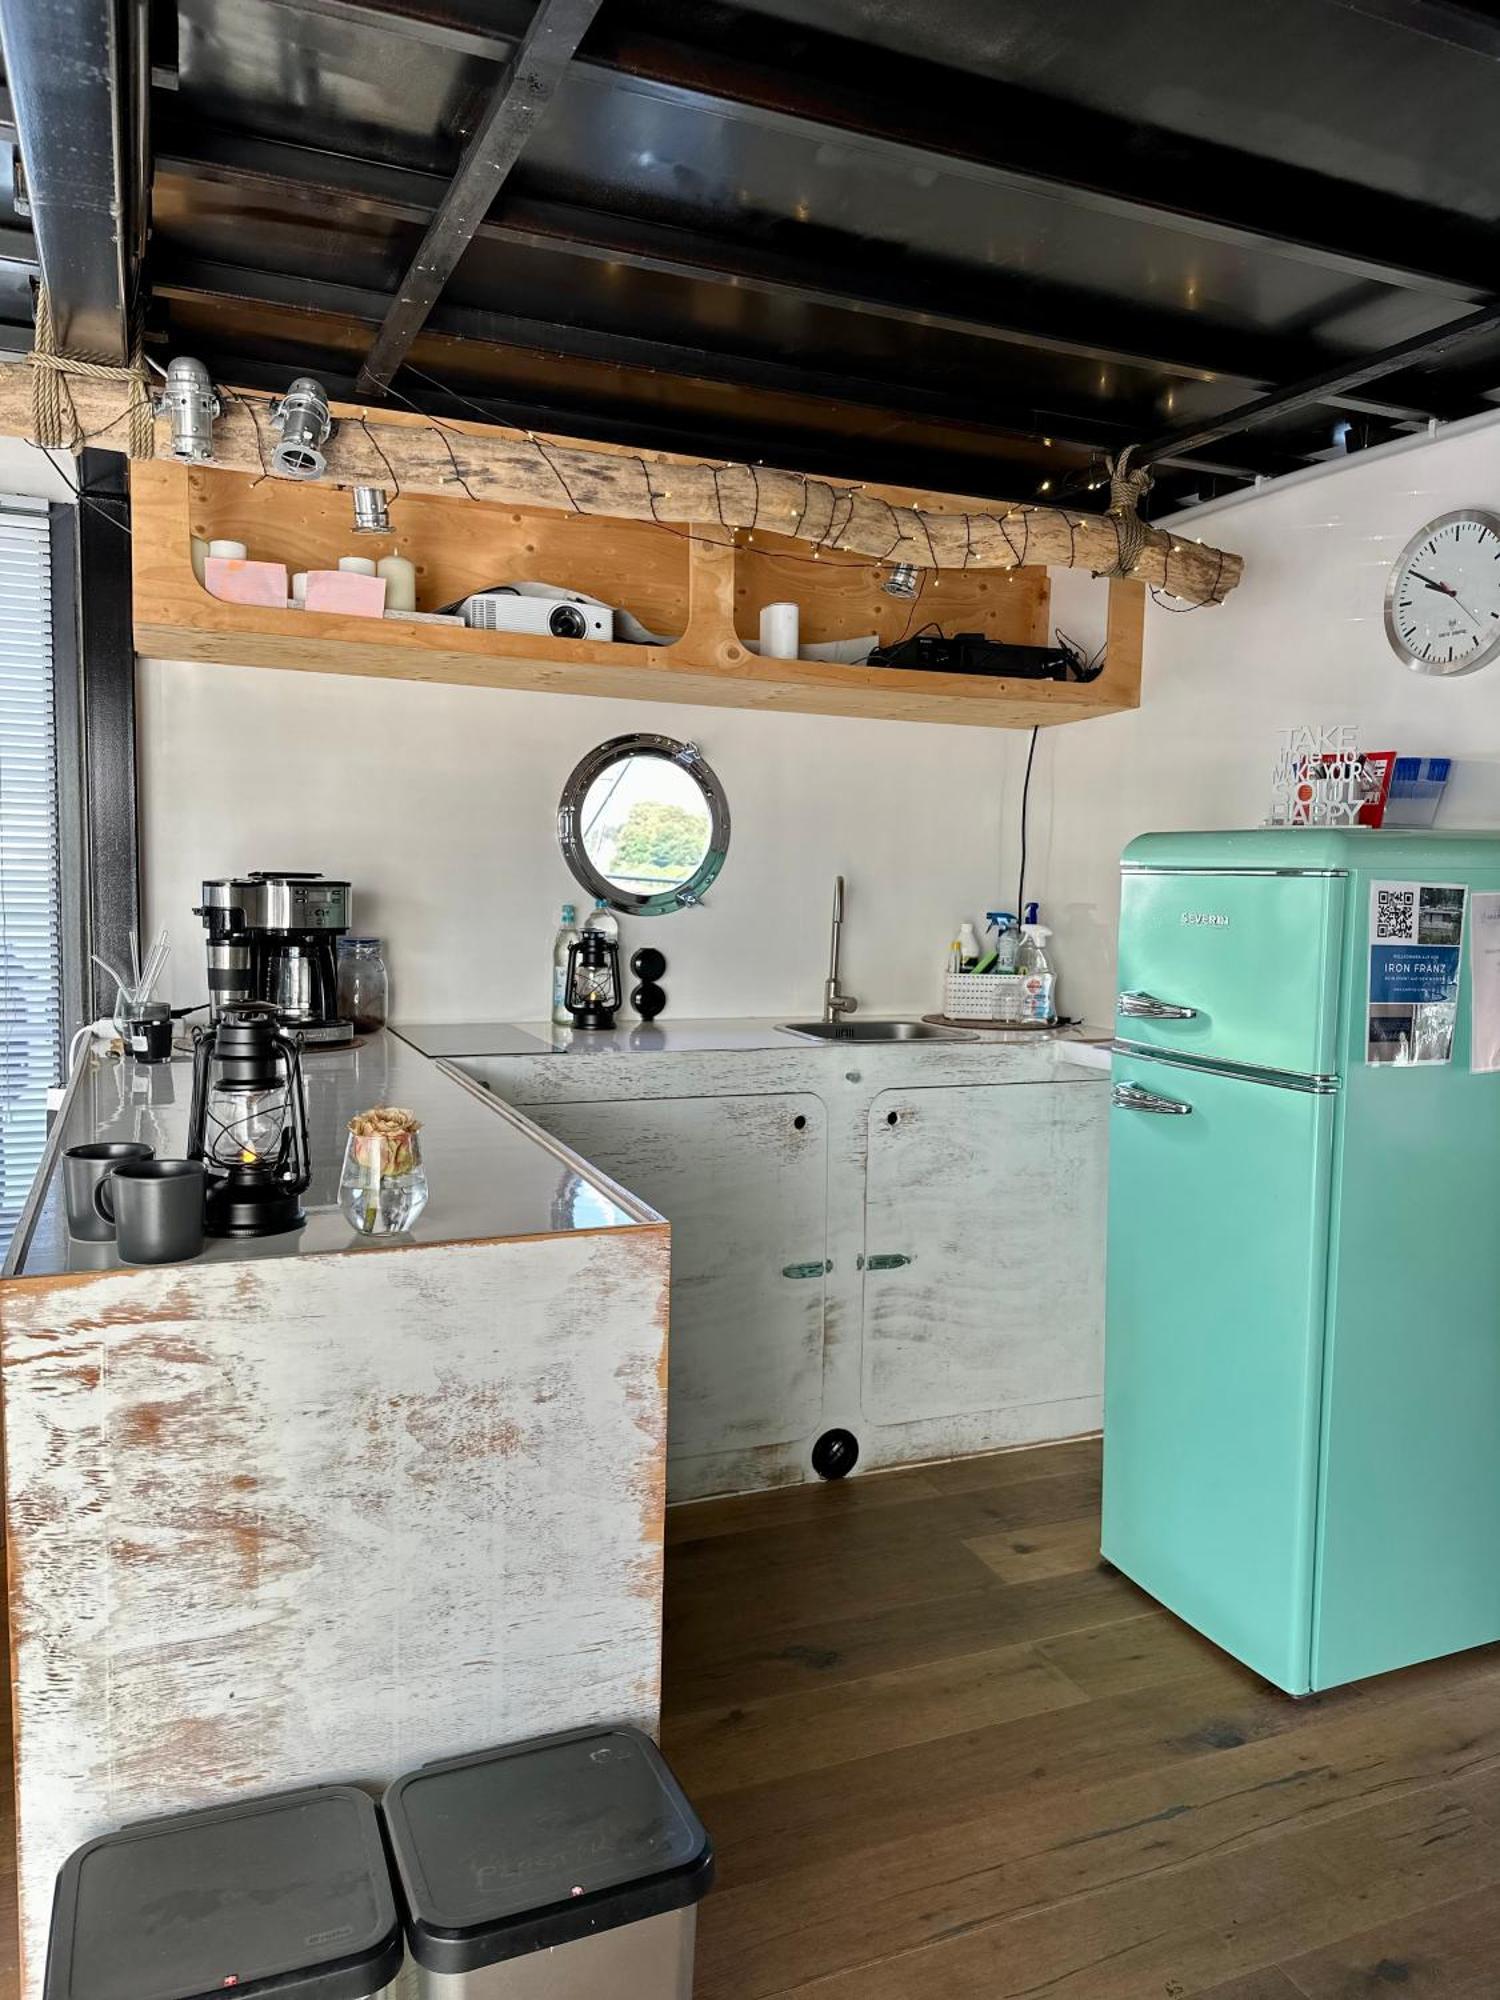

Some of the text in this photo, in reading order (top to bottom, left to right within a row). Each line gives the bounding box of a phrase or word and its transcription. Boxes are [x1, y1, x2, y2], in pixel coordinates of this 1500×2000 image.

[1277, 725, 1361, 751] TAKE
[1322, 763, 1362, 783] YOUR
[1272, 801, 1364, 825] HAPPY
[1384, 963, 1446, 973] IRON FRANZ
